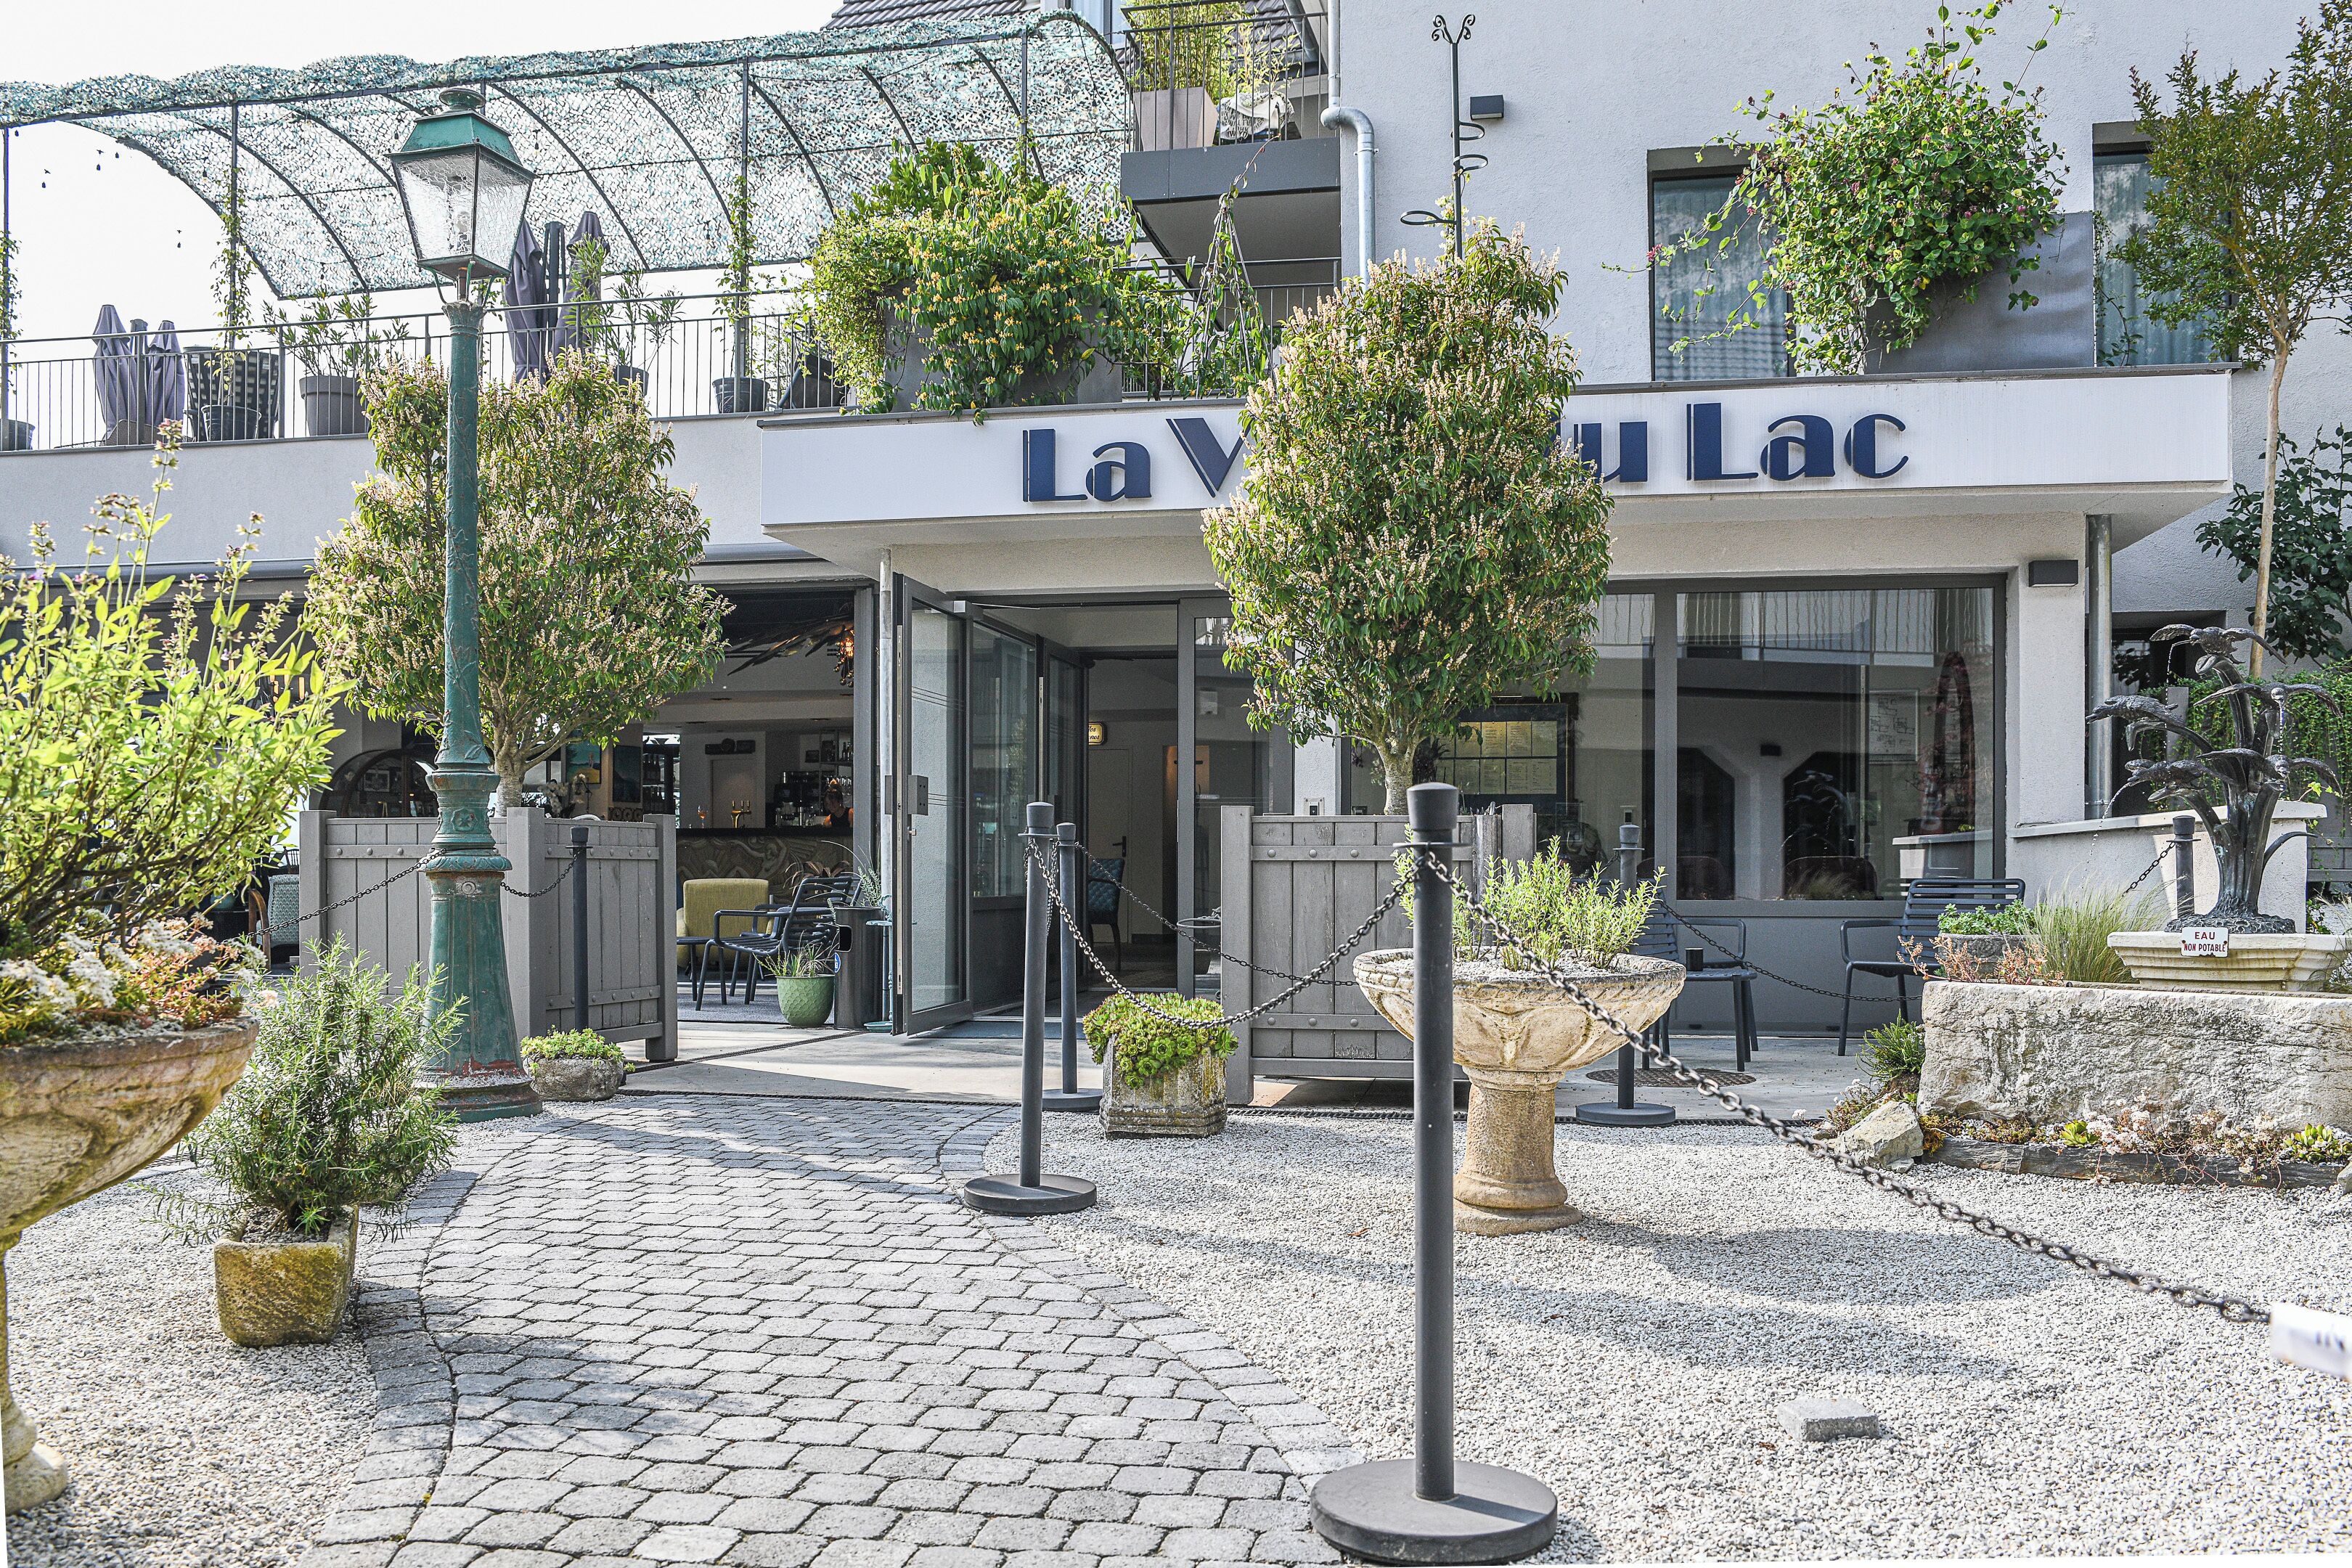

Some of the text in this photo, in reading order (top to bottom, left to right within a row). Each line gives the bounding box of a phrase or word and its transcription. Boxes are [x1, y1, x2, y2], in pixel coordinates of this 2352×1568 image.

[1022, 428, 1152, 502] La
[1546, 408, 1648, 483] u
[1686, 401, 1909, 481] Lac
[2184, 943, 2226, 952] NON POTABLE
